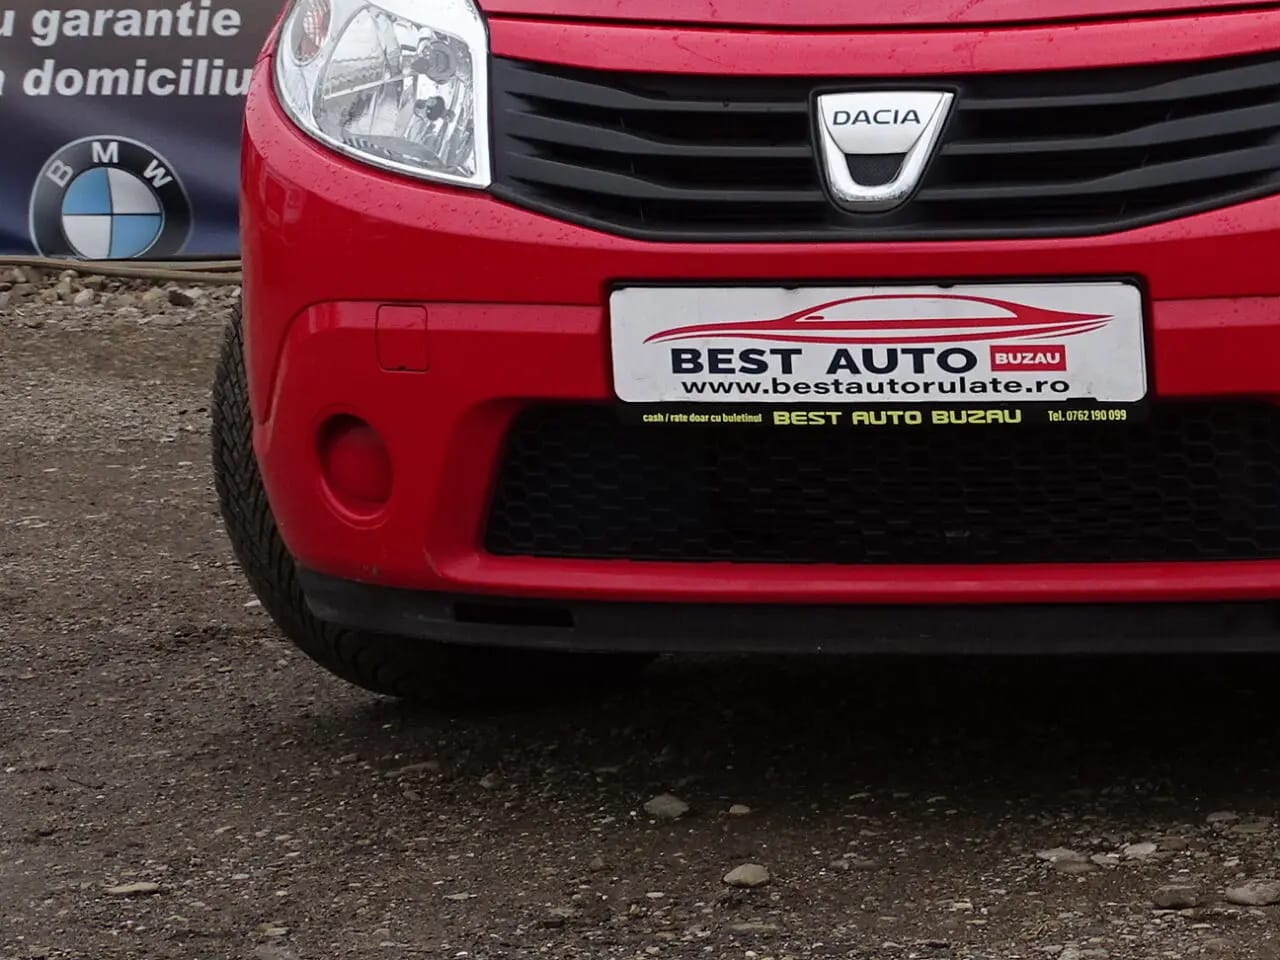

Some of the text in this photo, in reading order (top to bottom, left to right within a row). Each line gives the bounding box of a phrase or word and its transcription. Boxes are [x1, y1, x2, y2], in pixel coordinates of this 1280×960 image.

[31, 0, 242, 46] garantie
[22, 58, 252, 96] domiciliu
[832, 109, 921, 126] DACIA
[46, 141, 173, 189] BMW
[671, 347, 1060, 375] BEST AUTO BUZAU
[682, 376, 1070, 395] www.bestautorulate.ro
[643, 413, 664, 423] cash
[670, 413, 688, 423] rate
[689, 413, 709, 423] doar
[710, 414, 721, 423] cu
[773, 409, 1022, 425] BEST AUTO BUZAU
[1048, 409, 1127, 422] Tel. 0762 190 099
